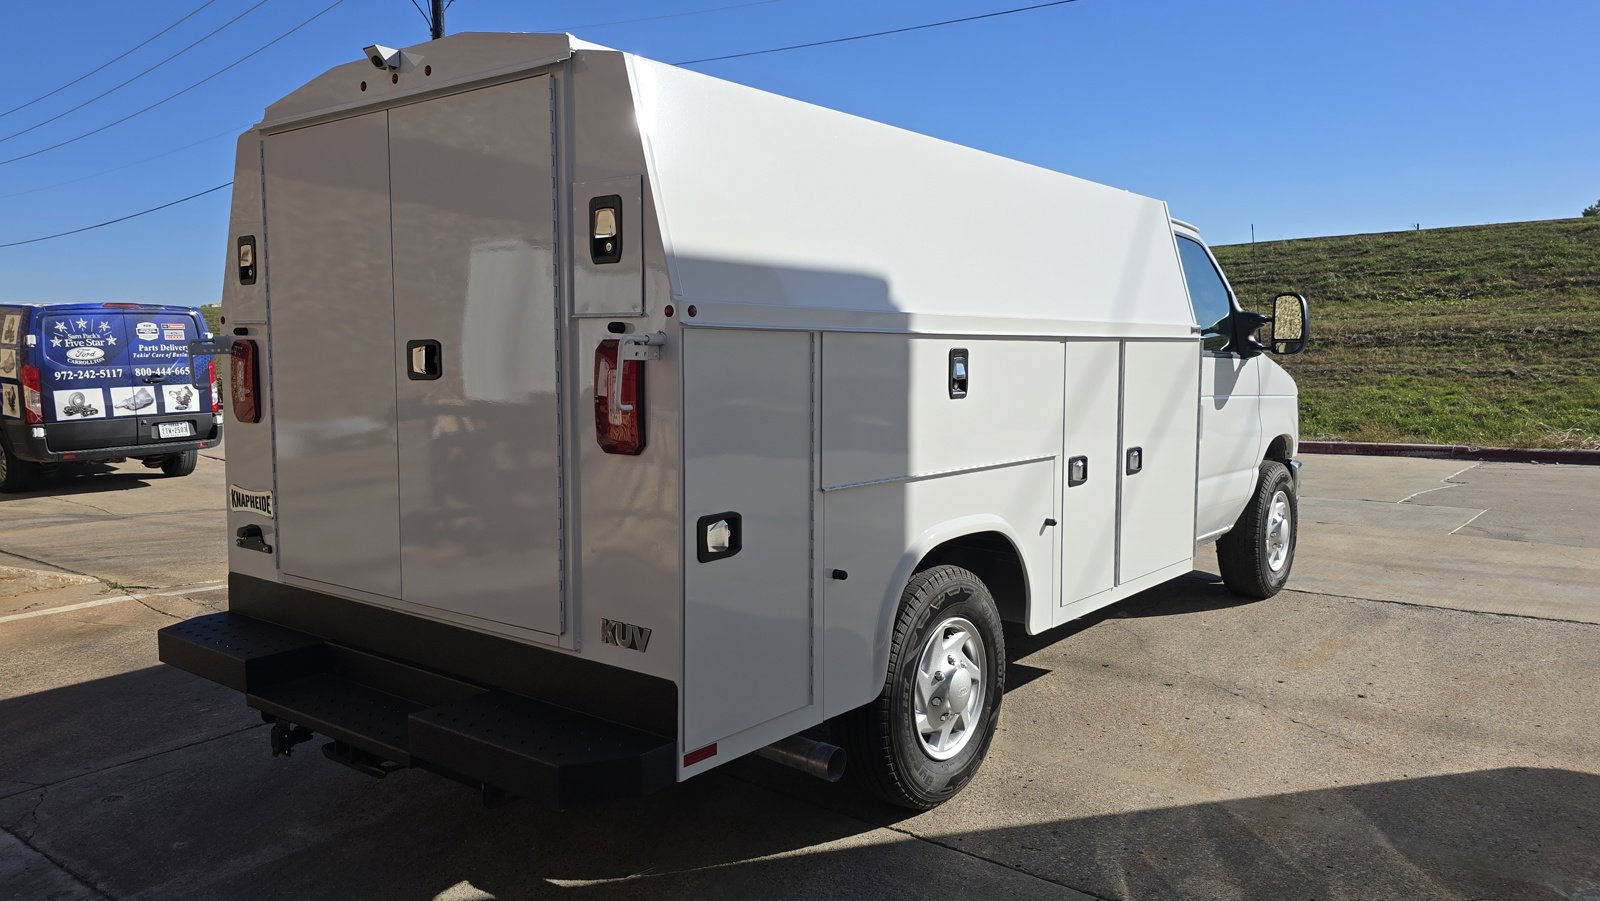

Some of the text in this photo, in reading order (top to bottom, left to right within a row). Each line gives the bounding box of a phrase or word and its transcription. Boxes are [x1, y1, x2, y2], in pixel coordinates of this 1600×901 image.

[64, 338, 105, 347] Five Star
[75, 348, 97, 358] Ford
[138, 344, 159, 352] Parts
[67, 357, 105, 366] CARROLLTON
[54, 368, 123, 381] 972-242-5117
[134, 366, 191, 377] 800-444-665
[231, 489, 272, 515] KNAPHEIDE
[600, 617, 652, 653] KUV
